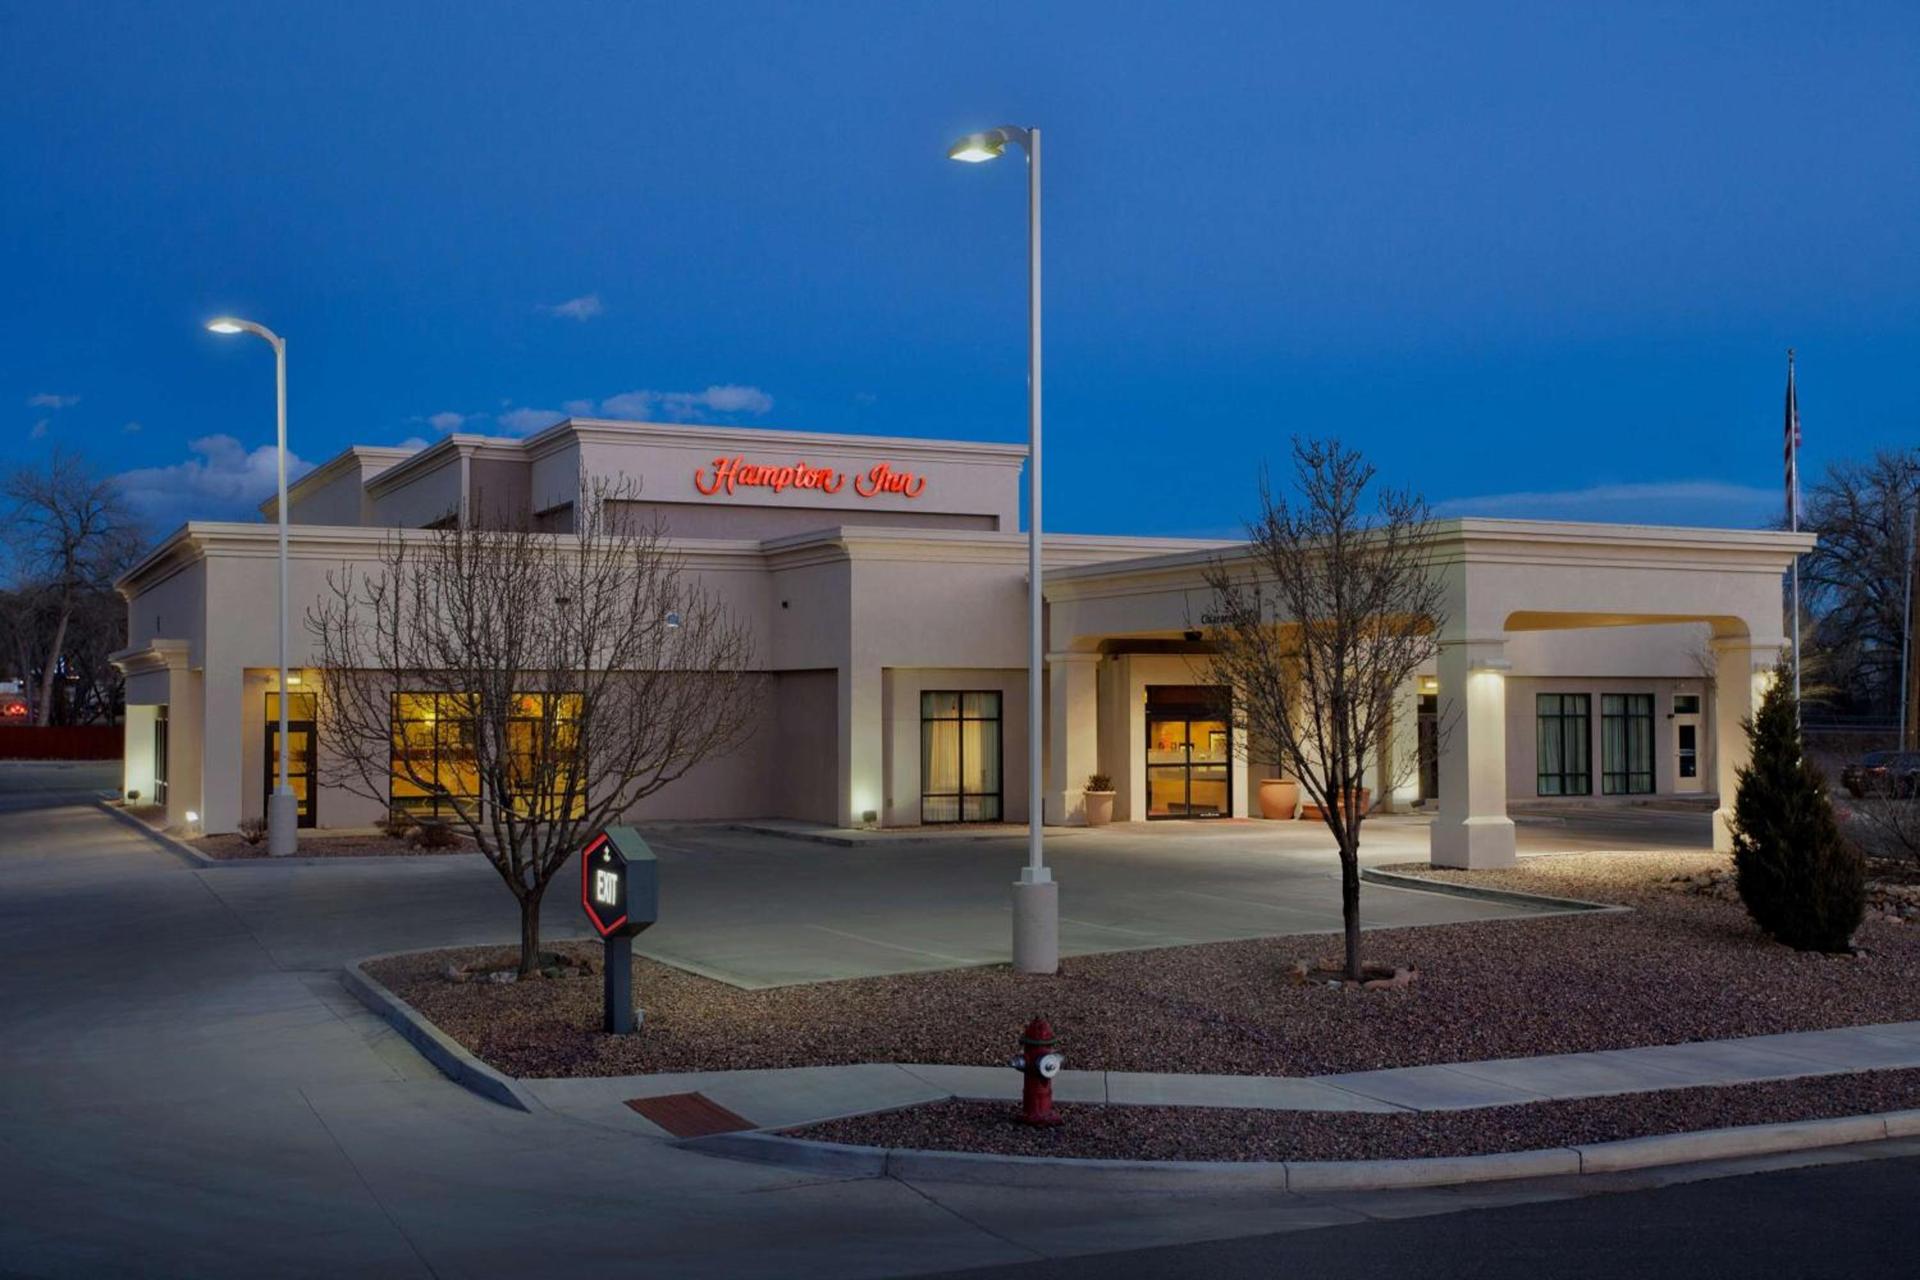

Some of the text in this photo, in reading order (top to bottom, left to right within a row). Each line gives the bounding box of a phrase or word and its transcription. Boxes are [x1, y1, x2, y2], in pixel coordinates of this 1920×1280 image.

[695, 455, 926, 498] Hampton Inn
[596, 869, 618, 906] EXIT
